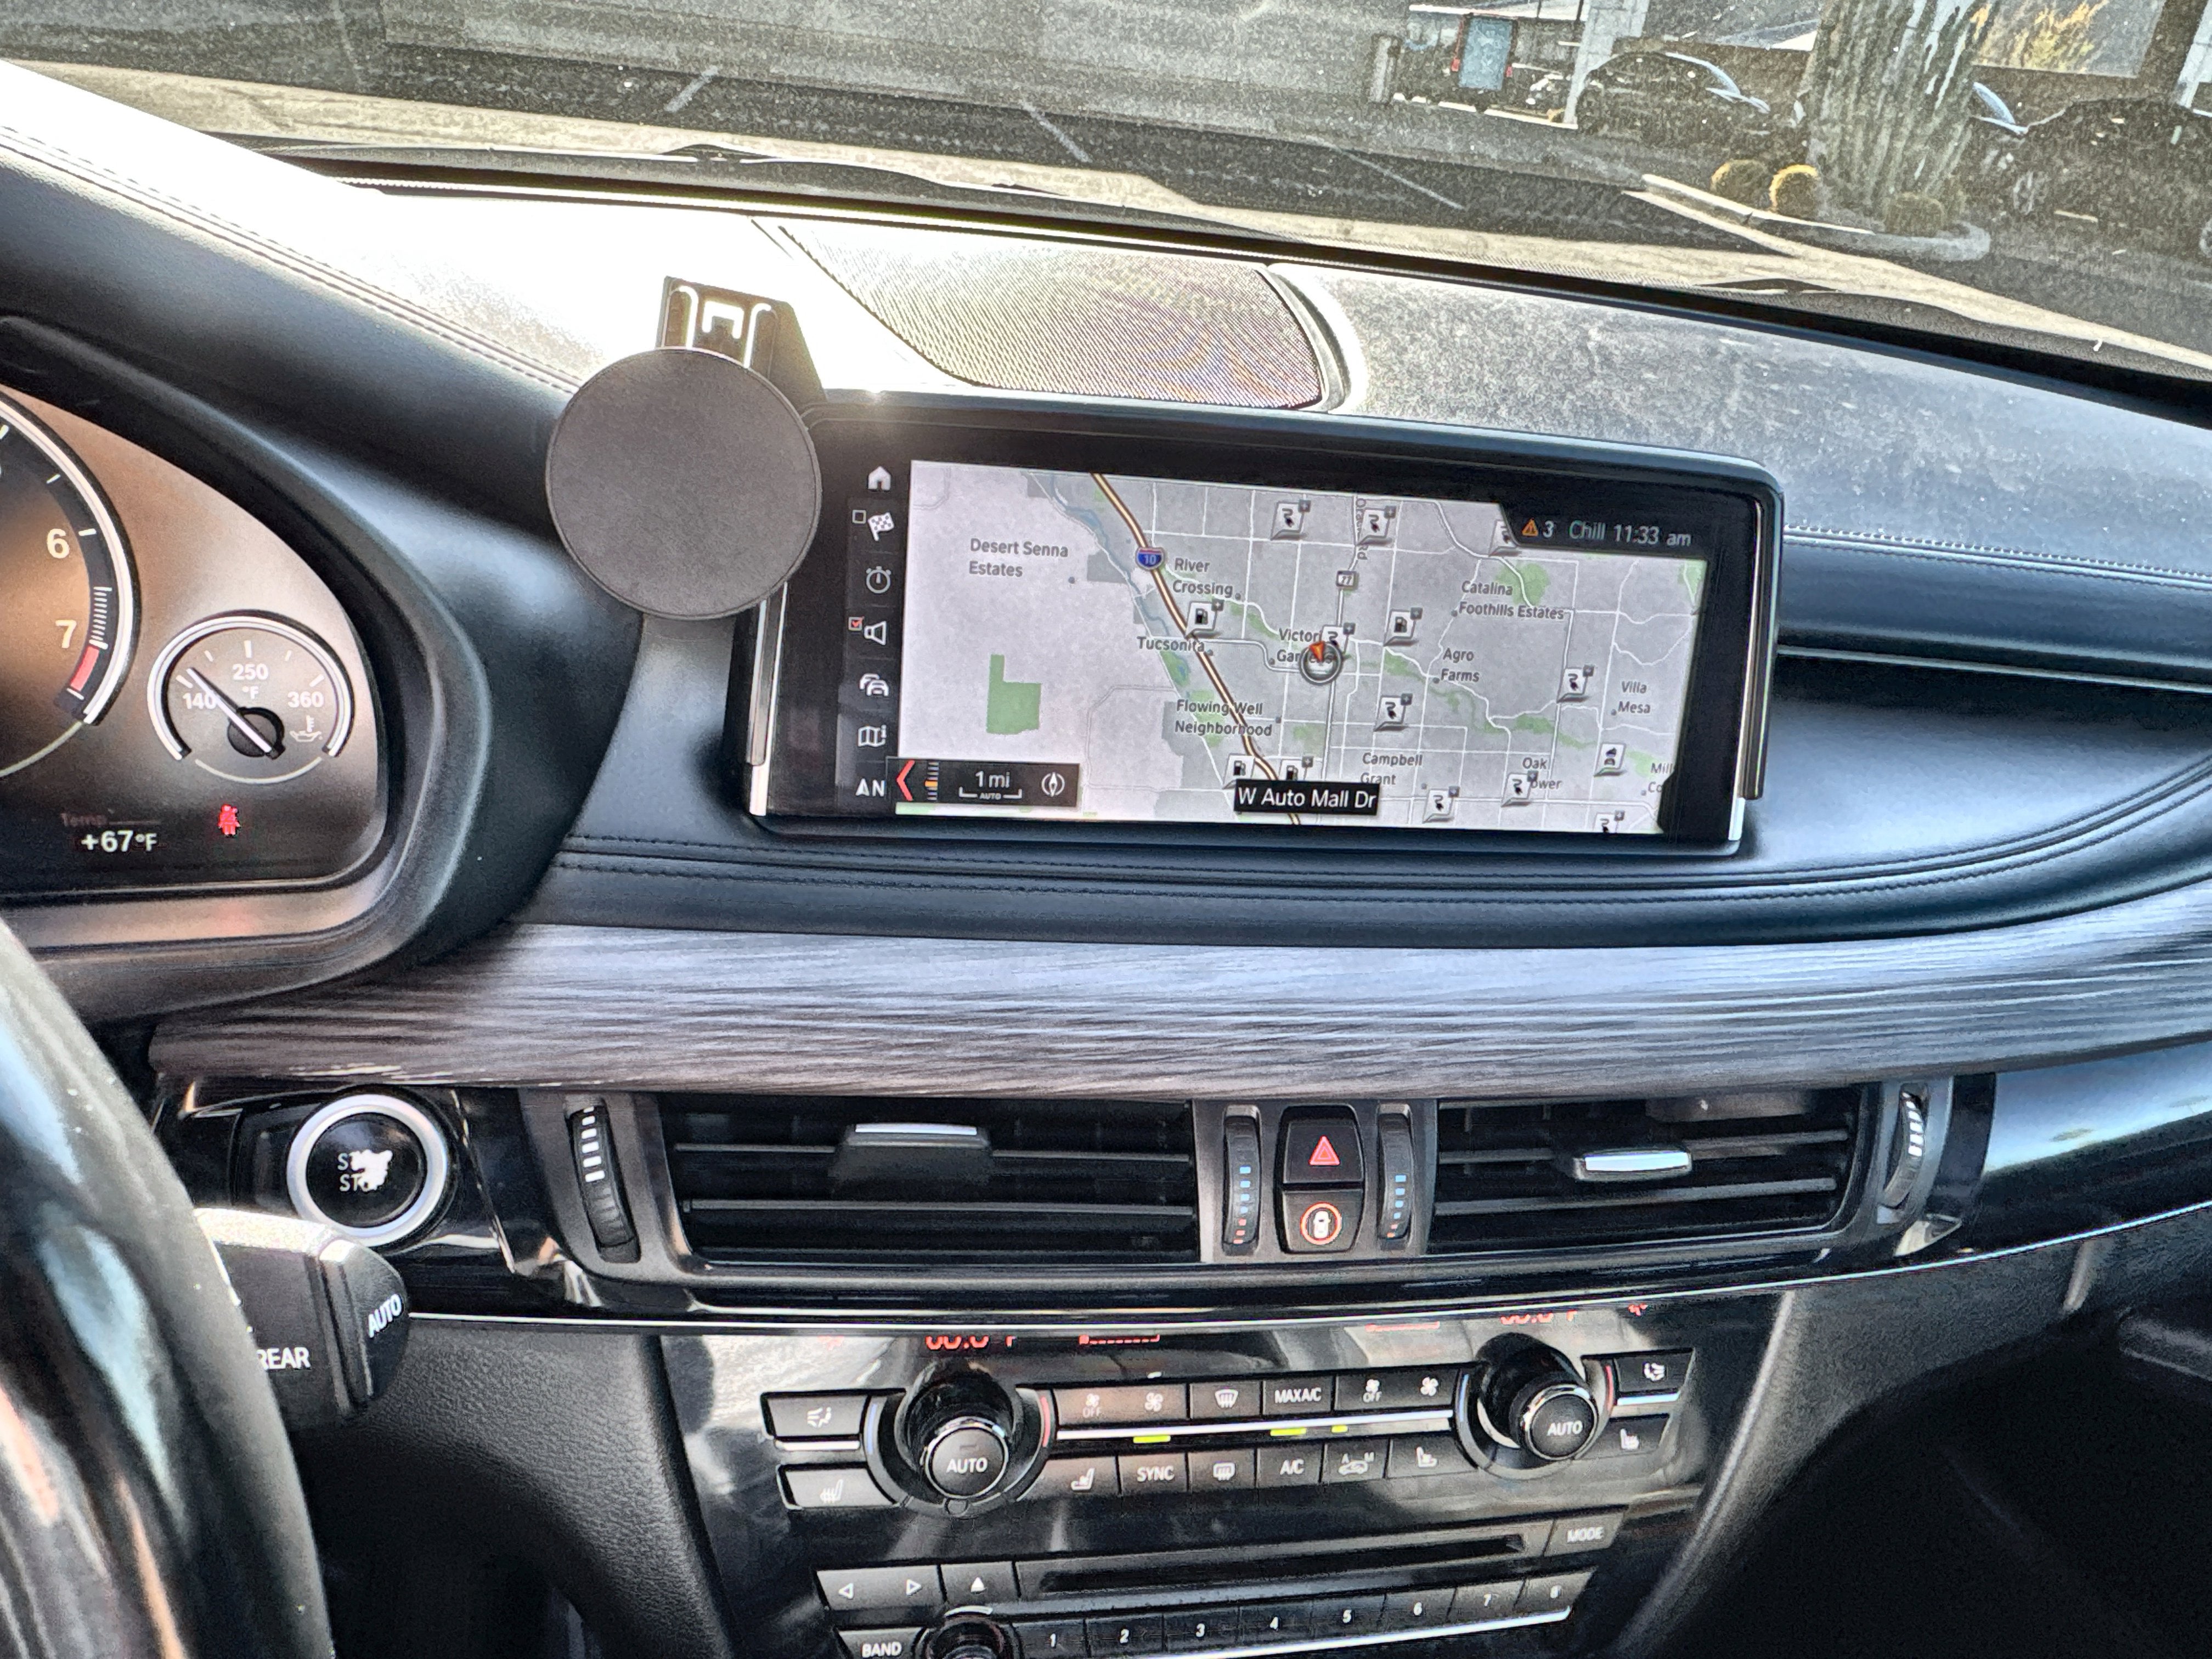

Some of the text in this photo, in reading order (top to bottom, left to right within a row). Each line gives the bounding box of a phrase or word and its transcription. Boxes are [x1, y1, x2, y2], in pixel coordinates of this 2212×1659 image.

[1542, 521, 1691, 546] 3 Chill 11:33 am
[47, 528, 70, 558] 6
[970, 538, 1069, 557] Desert Senna
[969, 560, 1023, 577] Estates
[1144, 555, 1156, 565] 10
[1174, 557, 1210, 572] River
[1172, 579, 1233, 598] Crossing
[1461, 580, 1514, 596] Catalina
[1458, 601, 1565, 620] Foothills Estates
[55, 619, 77, 648] 7
[1137, 636, 1205, 652] Tucsonita
[1442, 647, 1475, 663] Agro
[232, 663, 269, 680] 250
[1441, 668, 1480, 683] Farms
[1621, 680, 1647, 694] Villa
[183, 693, 220, 710] 140
[287, 691, 324, 708] 360
[1176, 699, 1263, 716] Flowing Well
[1618, 701, 1651, 714] Mesa
[1175, 720, 1272, 736] Neighborhood
[1362, 752, 1423, 767] Campbell
[1522, 757, 1548, 770] Oak
[975, 770, 1011, 789] 1 mi
[1360, 772, 1397, 786] Grant
[979, 792, 1002, 800] AUTO
[1238, 787, 1377, 809] W Auto Mall Dr
[369, 1294, 402, 1338] AUTO
[257, 1347, 311, 1369] REAR
[1363, 1391, 1383, 1403] OFF
[1082, 1406, 1101, 1418] OFF
[1547, 1420, 1583, 1437] AUTO
[946, 1457, 988, 1474] AUTO
[1137, 1465, 1175, 1482] SYNC
[1279, 1458, 1305, 1475] A/C
[1567, 1526, 1604, 1543] MODE
[1049, 1633, 1057, 1647] 1
[1120, 1628, 1130, 1644] 2
[1195, 1623, 1205, 1638] 3
[1269, 1616, 1279, 1630] 4
[1342, 1609, 1352, 1624] 5
[1413, 1602, 1423, 1616] 6
[1483, 1593, 1493, 1607] 7
[861, 1641, 902, 1658] BAND
